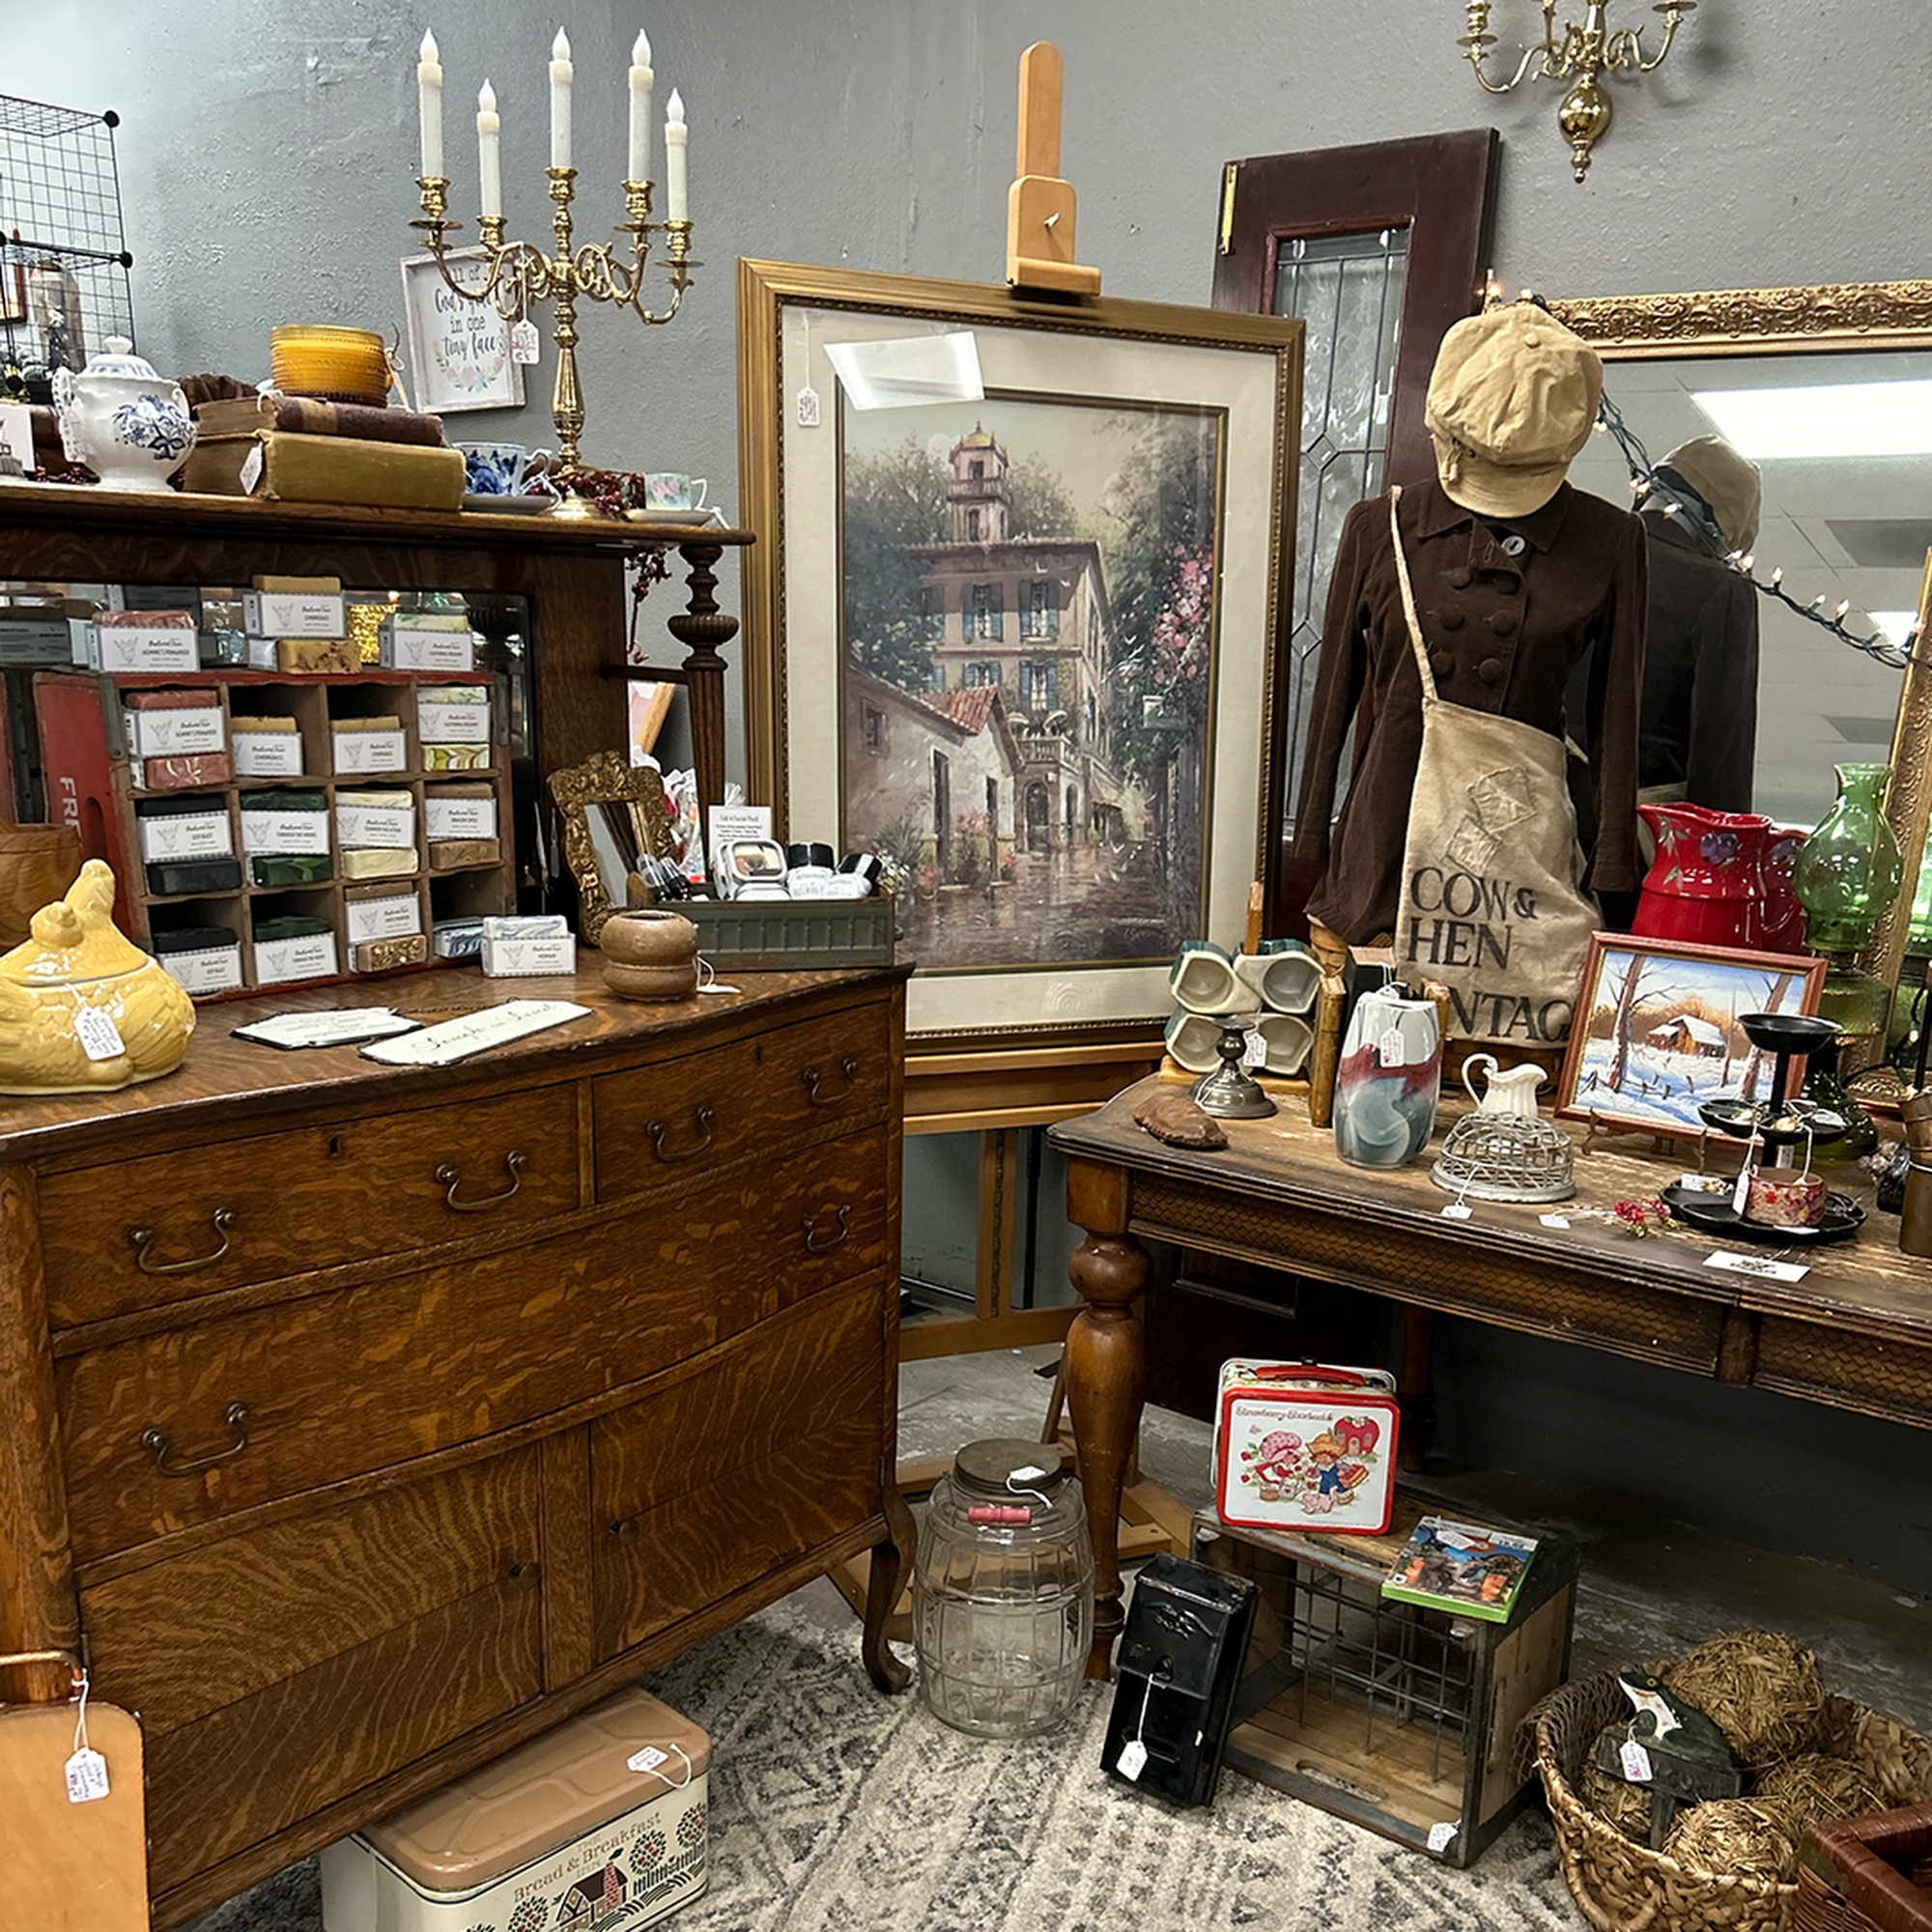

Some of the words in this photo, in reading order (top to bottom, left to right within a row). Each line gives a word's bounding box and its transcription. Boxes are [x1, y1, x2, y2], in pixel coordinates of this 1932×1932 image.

[450, 316, 464, 333] in
[1406, 917, 1513, 970] HEN
[1449, 985, 1572, 1042] NTAG
[1236, 1406, 1287, 1421] Strawberry
[513, 1863, 564, 1903] Bread
[566, 1857, 581, 1873] &
[582, 1811, 663, 1864] Breakfast
